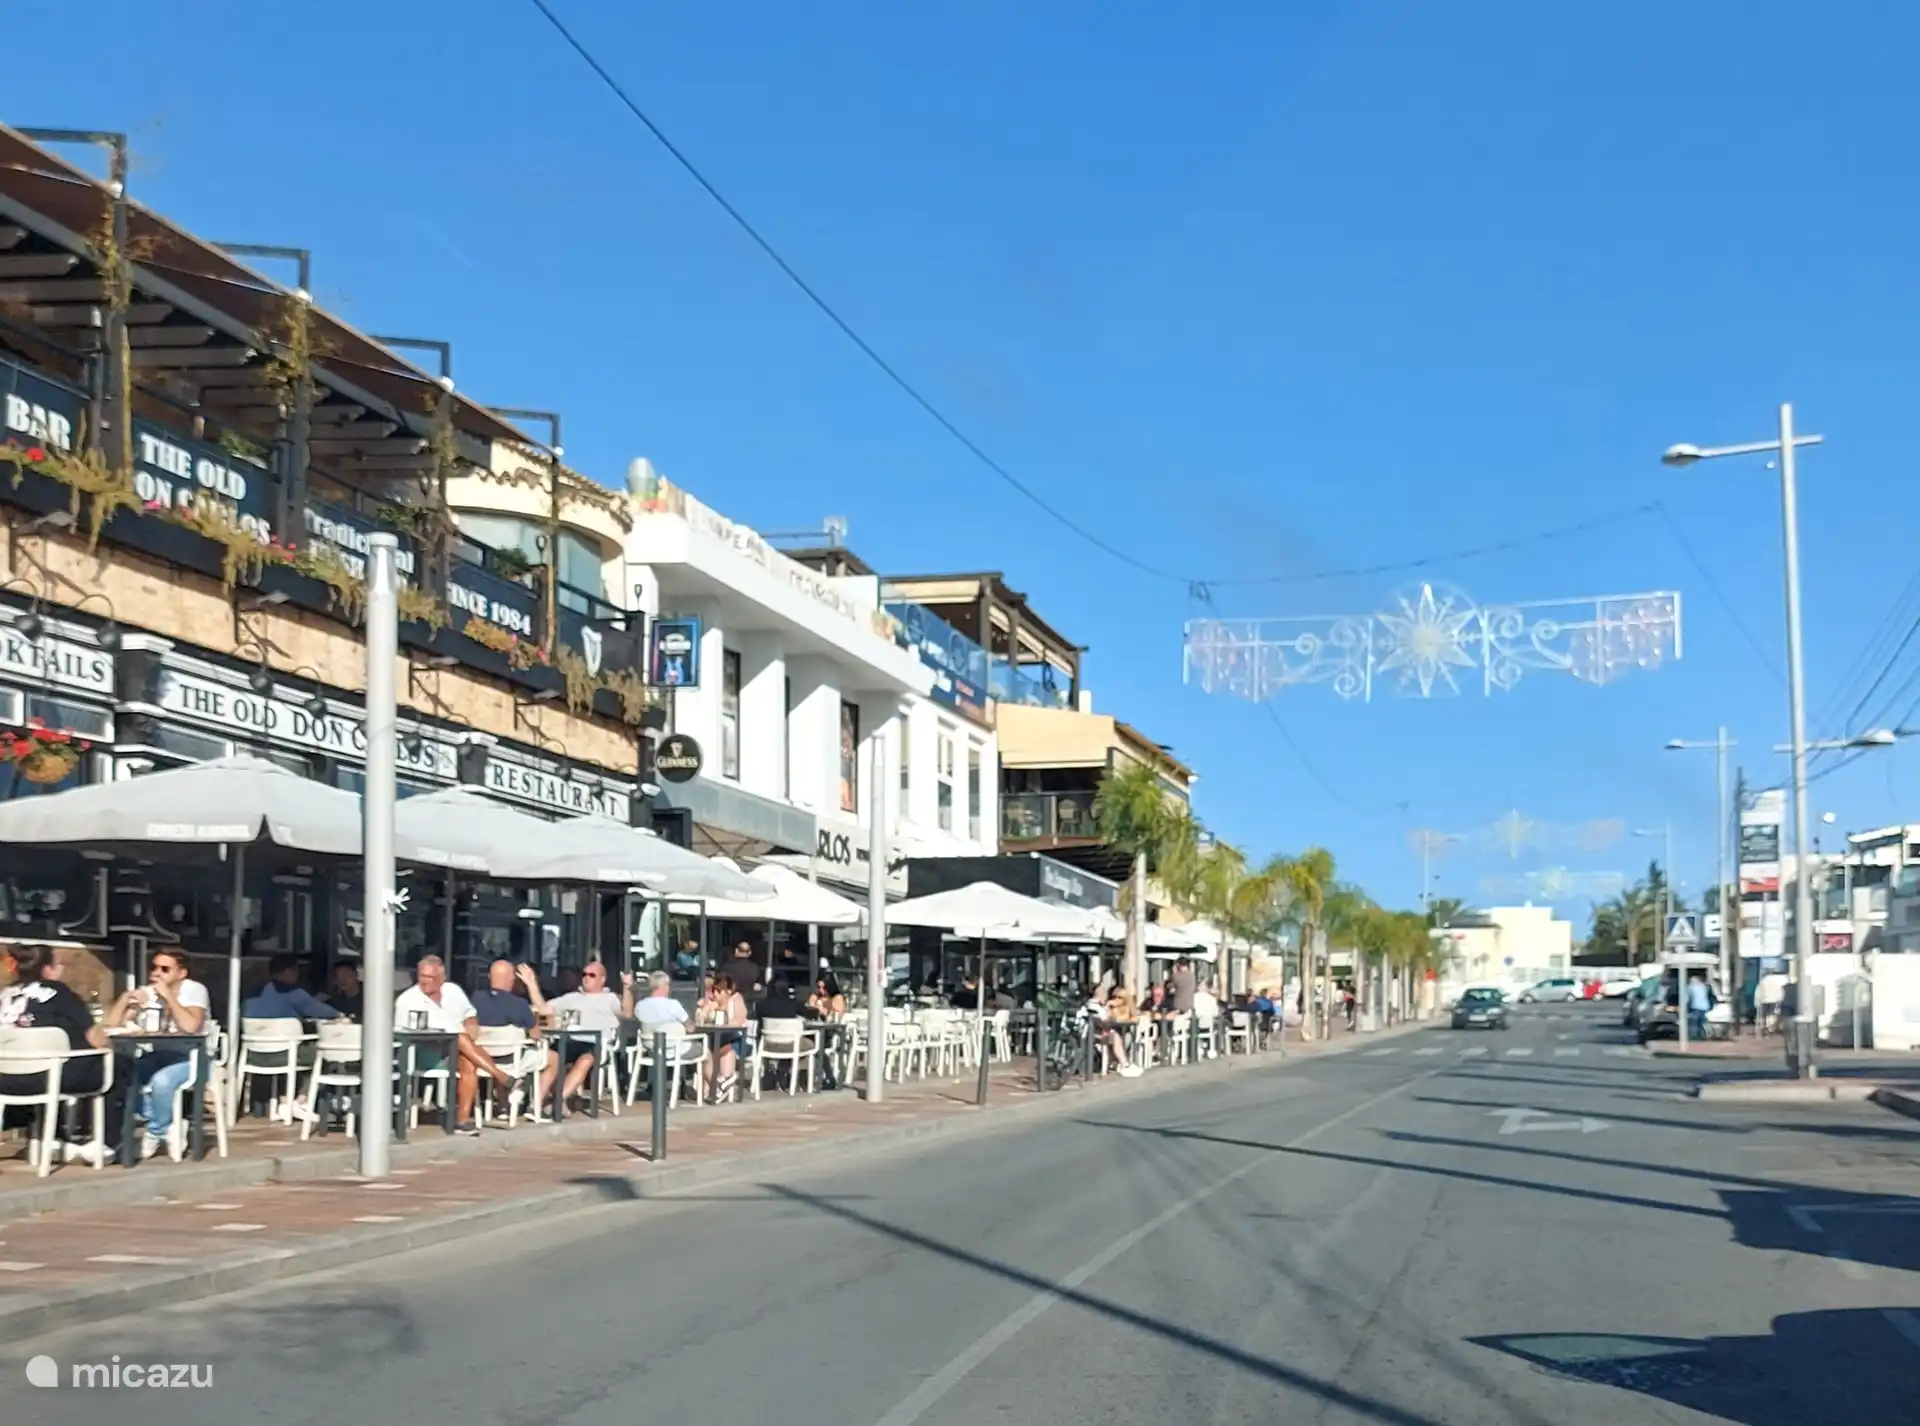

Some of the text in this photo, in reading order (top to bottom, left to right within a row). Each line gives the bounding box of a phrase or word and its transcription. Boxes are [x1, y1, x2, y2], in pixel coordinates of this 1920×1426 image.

[5, 392, 71, 450] BAR
[135, 470, 173, 509] ON
[140, 431, 247, 500] THE OLD
[491, 601, 531, 636] 1984
[0, 638, 105, 683] KTAILS
[180, 684, 435, 768] THE OLD DON CLS
[493, 763, 617, 816] RESTAURANT
[816, 828, 850, 867] RLOS
